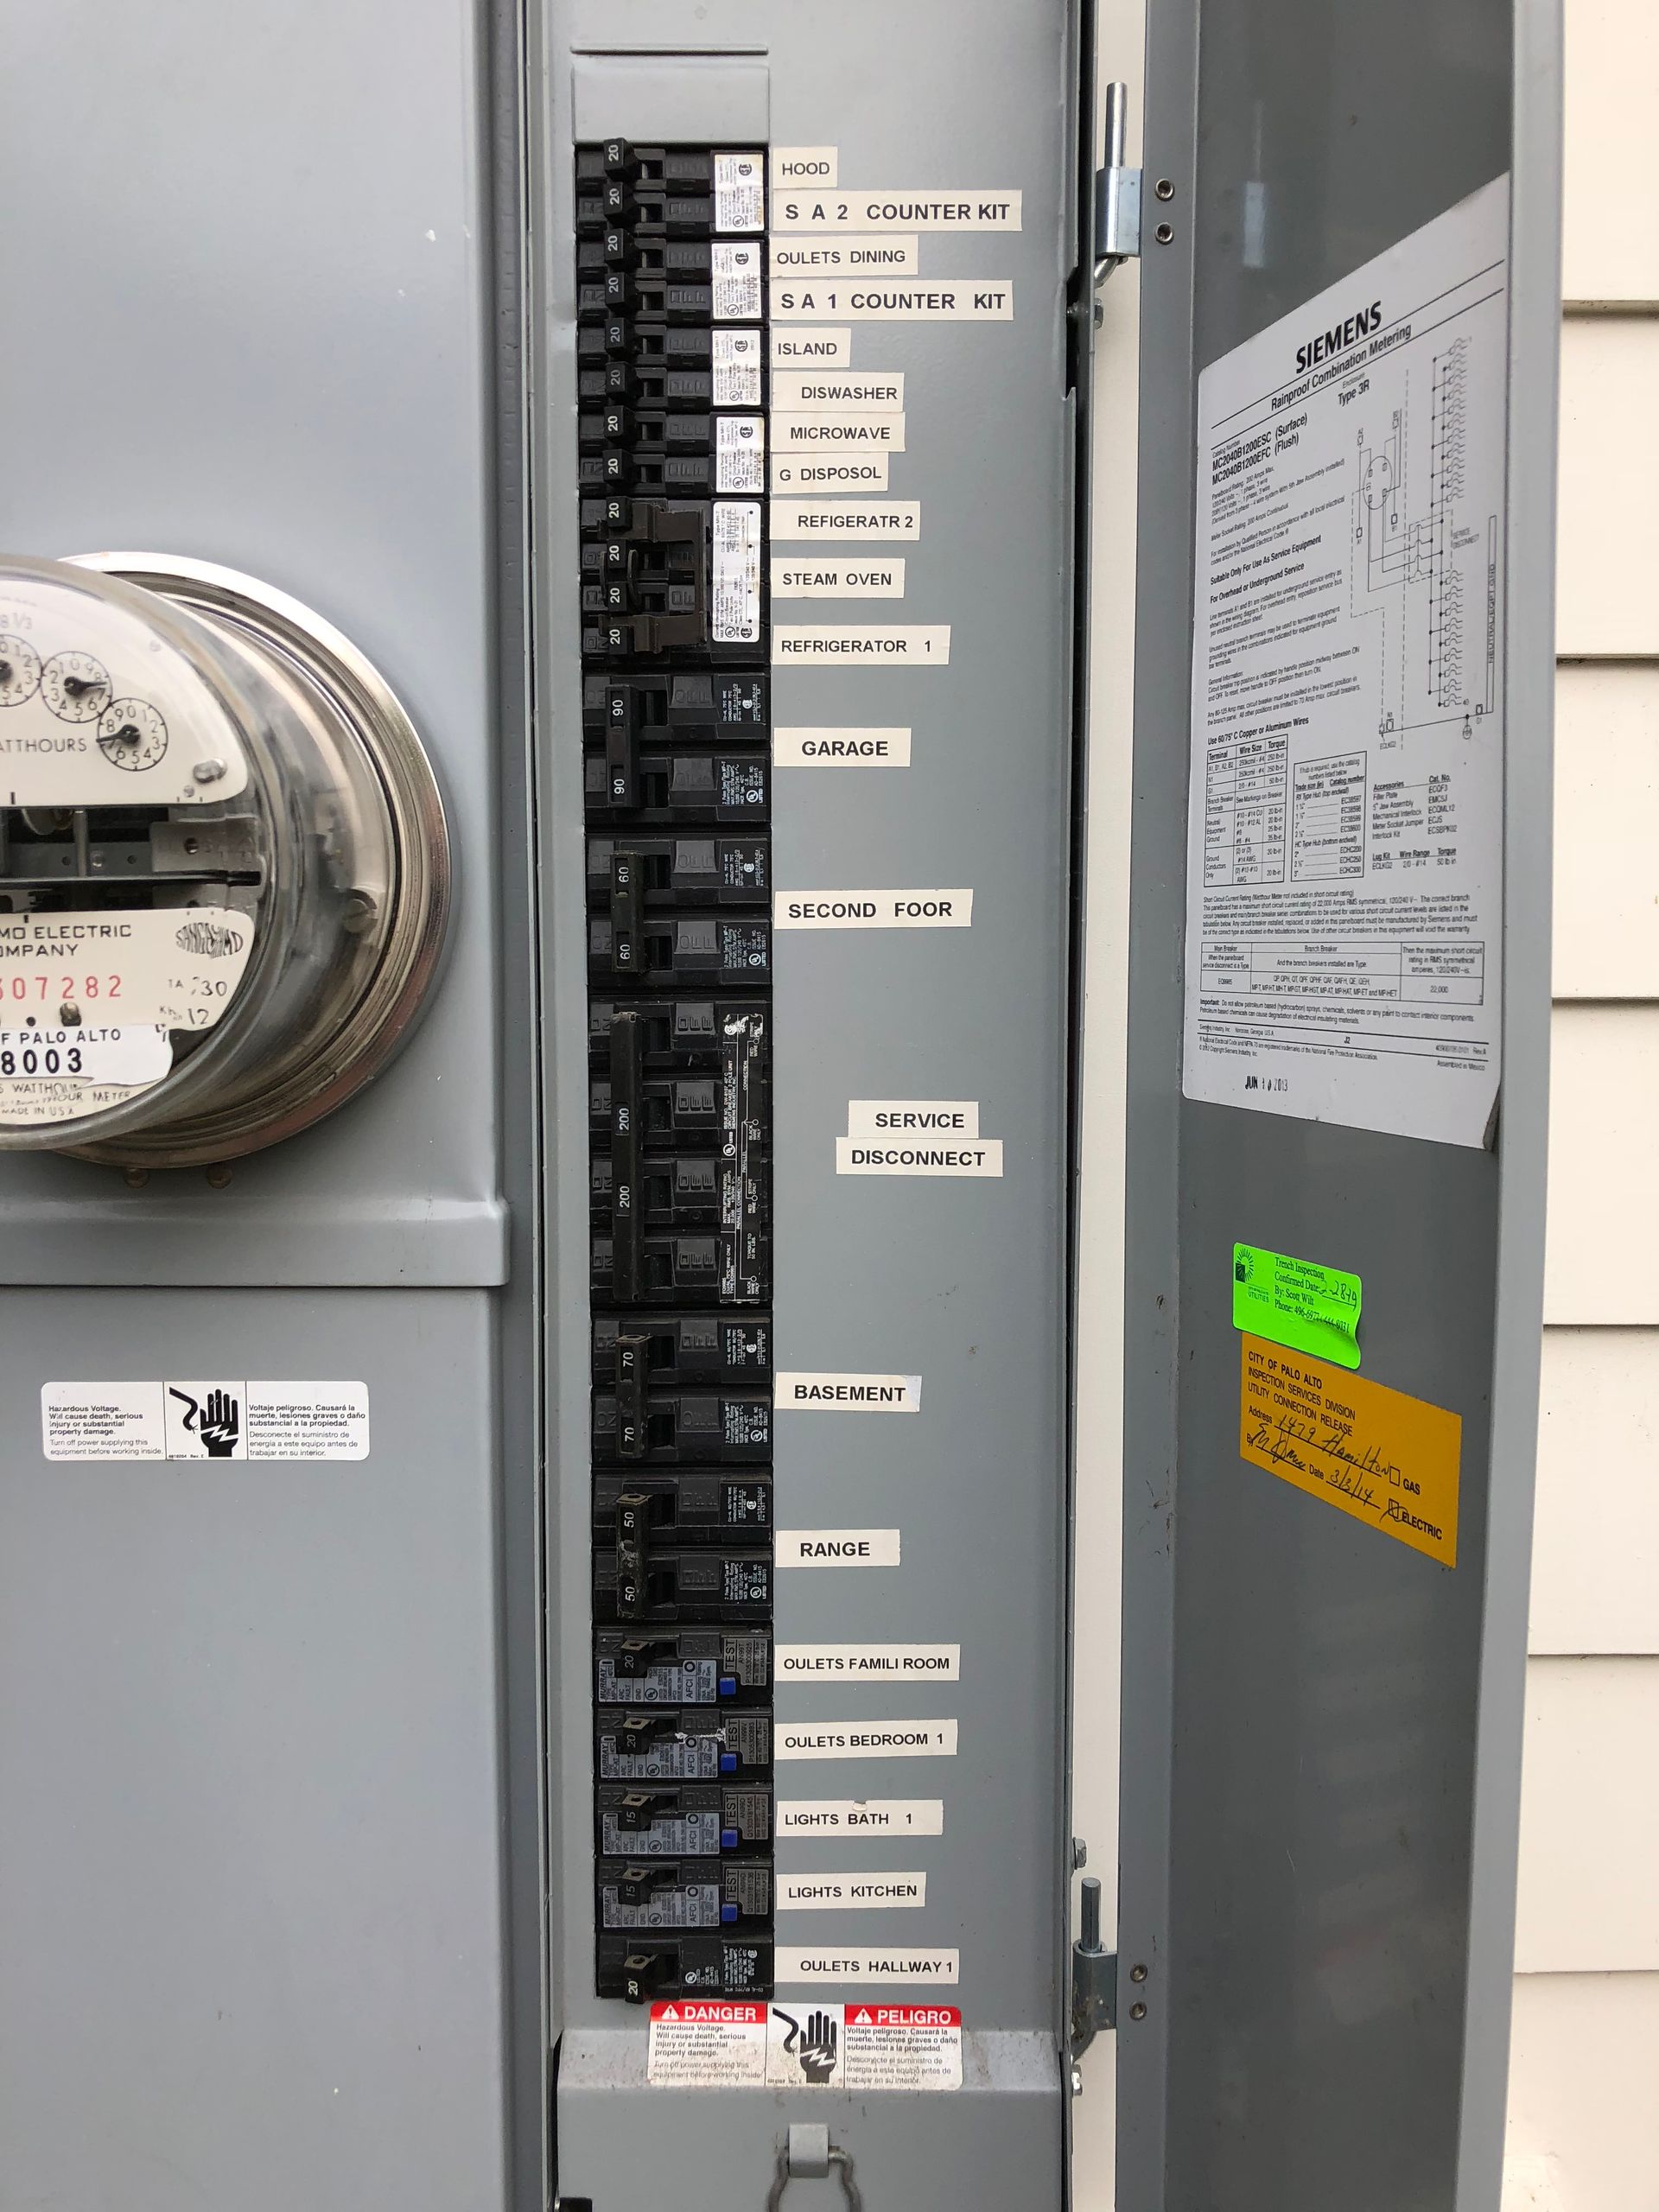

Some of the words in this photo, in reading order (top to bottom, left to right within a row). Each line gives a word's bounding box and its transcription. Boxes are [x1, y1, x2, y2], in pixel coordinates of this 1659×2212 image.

[608, 144, 619, 162] 20
[783, 162, 830, 175] HOOD
[609, 188, 620, 206] 20
[785, 205, 798, 219] S
[812, 205, 825, 219] A
[837, 205, 848, 219] 2
[867, 205, 970, 219] COUNTER
[979, 204, 1009, 219] KIT
[608, 235, 618, 252] 20
[778, 251, 840, 264] OULETS
[851, 251, 905, 263] DINING
[608, 276, 619, 293] 20
[781, 294, 794, 308] S
[802, 294, 815, 308] A
[829, 294, 836, 308] 1
[851, 294, 955, 308] COUNTER
[975, 294, 1005, 308] KIT
[610, 327, 620, 342] 20
[1296, 300, 1382, 374] SIEMENS
[779, 343, 836, 354] ISLAND
[1271, 378, 1311, 410] Rainproof
[1312, 349, 1367, 389] Combination
[1369, 324, 1412, 357] Metering
[611, 369, 620, 385] 20
[802, 387, 897, 399] DISWASHER
[1338, 389, 1357, 406] Type
[1358, 378, 1370, 395] 3R
[607, 416, 618, 431] 20
[791, 428, 890, 439] MICROWAVE
[1212, 431, 1272, 472] MC2040B1200ESC
[1274, 412, 1308, 441] (Surface)
[608, 458, 618, 474] 20
[1212, 446, 1272, 486] MC2040B1200EFC
[1274, 432, 1300, 456] (Flush)
[780, 469, 791, 480] G
[801, 467, 881, 480] DISPOSOL
[609, 502, 620, 518] 20
[798, 516, 899, 527] REFIGERATR
[906, 516, 912, 527] 2
[609, 545, 620, 561] 20
[1211, 571, 1230, 585] Suitable
[1230, 567, 1242, 578] Only
[1243, 562, 1252, 574] For
[1252, 559, 1262, 569] Use
[1262, 555, 1270, 565] As
[1271, 549, 1291, 562] Service
[1292, 535, 1321, 551] Equipment
[783, 574, 836, 585] STEAM
[847, 574, 891, 585] OVEN
[1210, 594, 1218, 604] For
[1218, 584, 1243, 601] Overhead
[1243, 582, 1249, 591] or
[1249, 570, 1283, 589] Underground
[1284, 563, 1305, 576] Service
[610, 588, 620, 603] 20
[609, 629, 620, 645] 20
[782, 640, 906, 652] REFRIGERATOR
[925, 640, 930, 652] 1
[612, 699, 623, 716] 90
[802, 741, 888, 755] GARAGE
[613, 779, 625, 794] 90
[618, 867, 629, 882] 60
[789, 903, 876, 918] SECOND
[895, 902, 951, 917] FOOR
[35, 924, 131, 939] ELECTRIC
[0, 944, 79, 957] MPANY
[620, 944, 630, 960] 60
[20, 1030, 67, 1045] PALO
[77, 1028, 121, 1042] ALTO
[1245, 1076, 1258, 1090] JUN
[619, 1108, 629, 1131] 200
[876, 1114, 964, 1128] SERVICE
[852, 1150, 985, 1166] DISCONNECT
[620, 1185, 630, 1208] 200
[1274, 1257, 1294, 1271] Trench
[1295, 1262, 1325, 1280] Inspection
[1274, 1271, 1304, 1287] Confirmed
[1248, 1291, 1269, 1303] UTILITIES
[1274, 1285, 1285, 1298] By:
[1274, 1299, 1294, 1313] Phone:
[623, 1351, 633, 1367] 70
[1249, 1351, 1265, 1366] CITY
[1268, 1358, 1278, 1370] OF
[1281, 1363, 1300, 1381] PALO
[1303, 1373, 1322, 1389] ALTO
[795, 1385, 906, 1401] BASEMENT
[1248, 1367, 1285, 1390] INSPECTION
[1287, 1383, 1321, 1406] SERVICES
[1325, 1398, 1356, 1421] DIVISION
[276, 1404, 314, 1413] peligroso.
[1248, 1382, 1270, 1400] UTILITY
[1273, 1393, 1317, 1421] CONNECTION
[1320, 1414, 1353, 1437] RELEASE
[1249, 1405, 1273, 1424] Address
[625, 1427, 634, 1442] 70
[1309, 1465, 1325, 1480] Date
[1402, 1478, 1421, 1496] GAS
[624, 1511, 634, 1528] 50
[1402, 1511, 1443, 1541] ELECTRIC
[801, 1542, 870, 1556] RANGE
[625, 1586, 635, 1601] 50
[625, 1655, 634, 1669] 20
[725, 1640, 734, 1670] TEST
[785, 1659, 843, 1669] OULETS
[849, 1658, 898, 1669] FAMILI
[904, 1658, 949, 1669] ROOM
[626, 1734, 636, 1748] 20
[729, 1720, 739, 1750] TEST
[785, 1736, 845, 1747] OULETS
[850, 1734, 927, 1745] BEDROOM
[938, 1733, 942, 1744] 1
[626, 1811, 636, 1824] 15
[727, 1795, 736, 1826] TEST
[785, 1815, 838, 1825] LIGHTS
[849, 1814, 888, 1824] BATH
[906, 1814, 911, 1824] 1
[626, 1885, 635, 1897] 15
[727, 1870, 736, 1901] TEST
[789, 1887, 842, 1897] LIGHTS
[852, 1885, 916, 1897] KITCHEN
[801, 1961, 860, 1971] OULETS
[869, 1961, 941, 1972] HALLWAY
[947, 1962, 951, 1972] 1
[628, 1980, 638, 1996] 20
[684, 2005, 757, 2021] DANGER
[877, 2009, 952, 2024] PELIGRO
